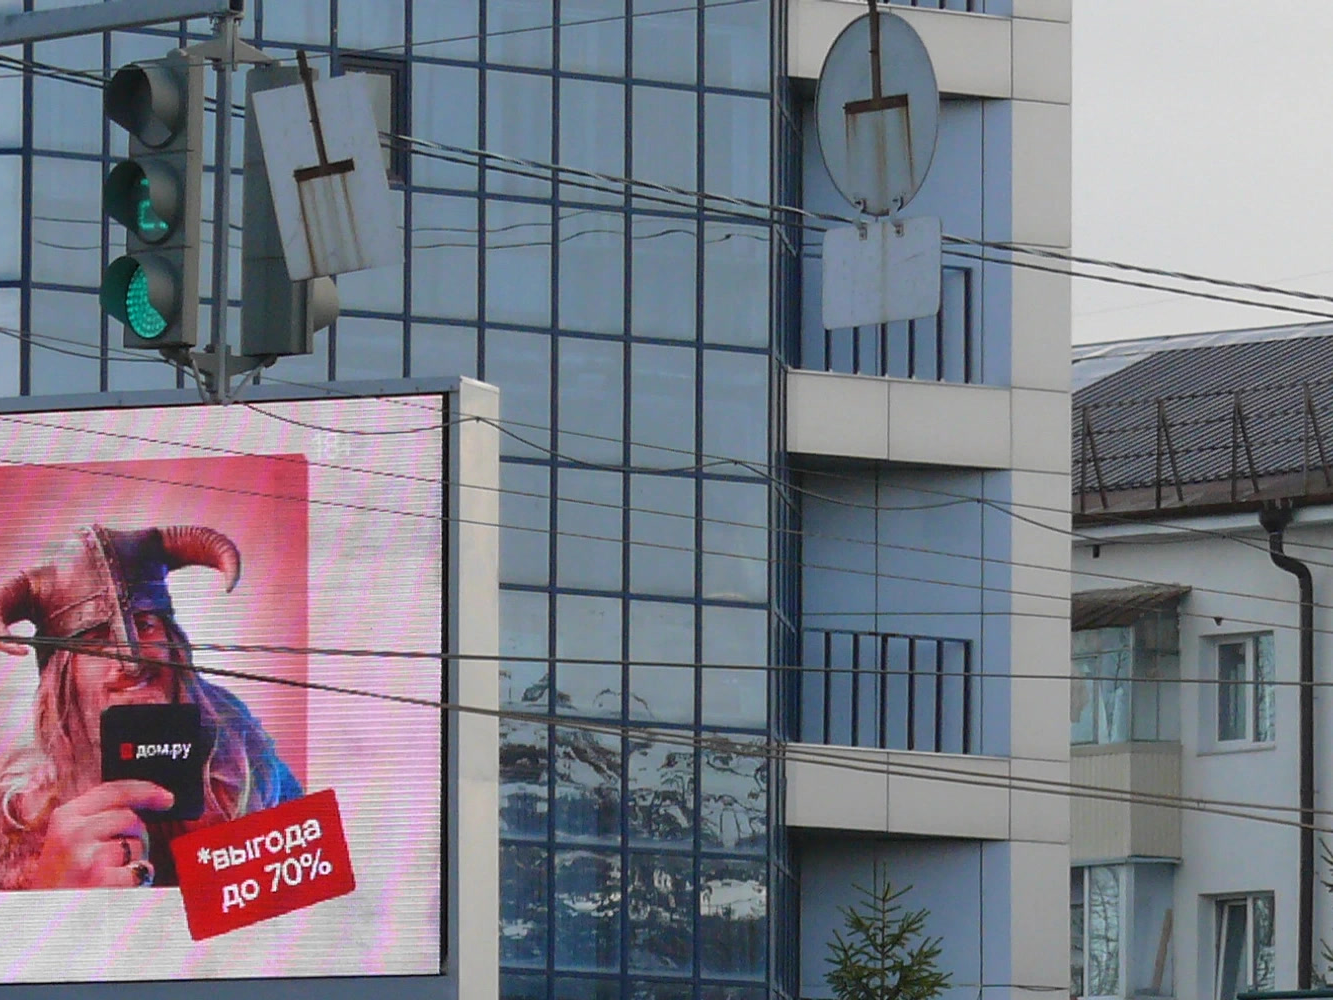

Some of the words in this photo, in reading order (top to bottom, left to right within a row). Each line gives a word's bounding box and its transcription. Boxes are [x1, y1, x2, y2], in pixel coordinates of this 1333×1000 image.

[135, 742, 192, 760] дом.ру
[222, 879, 260, 913] до
[264, 848, 332, 892] 70%
